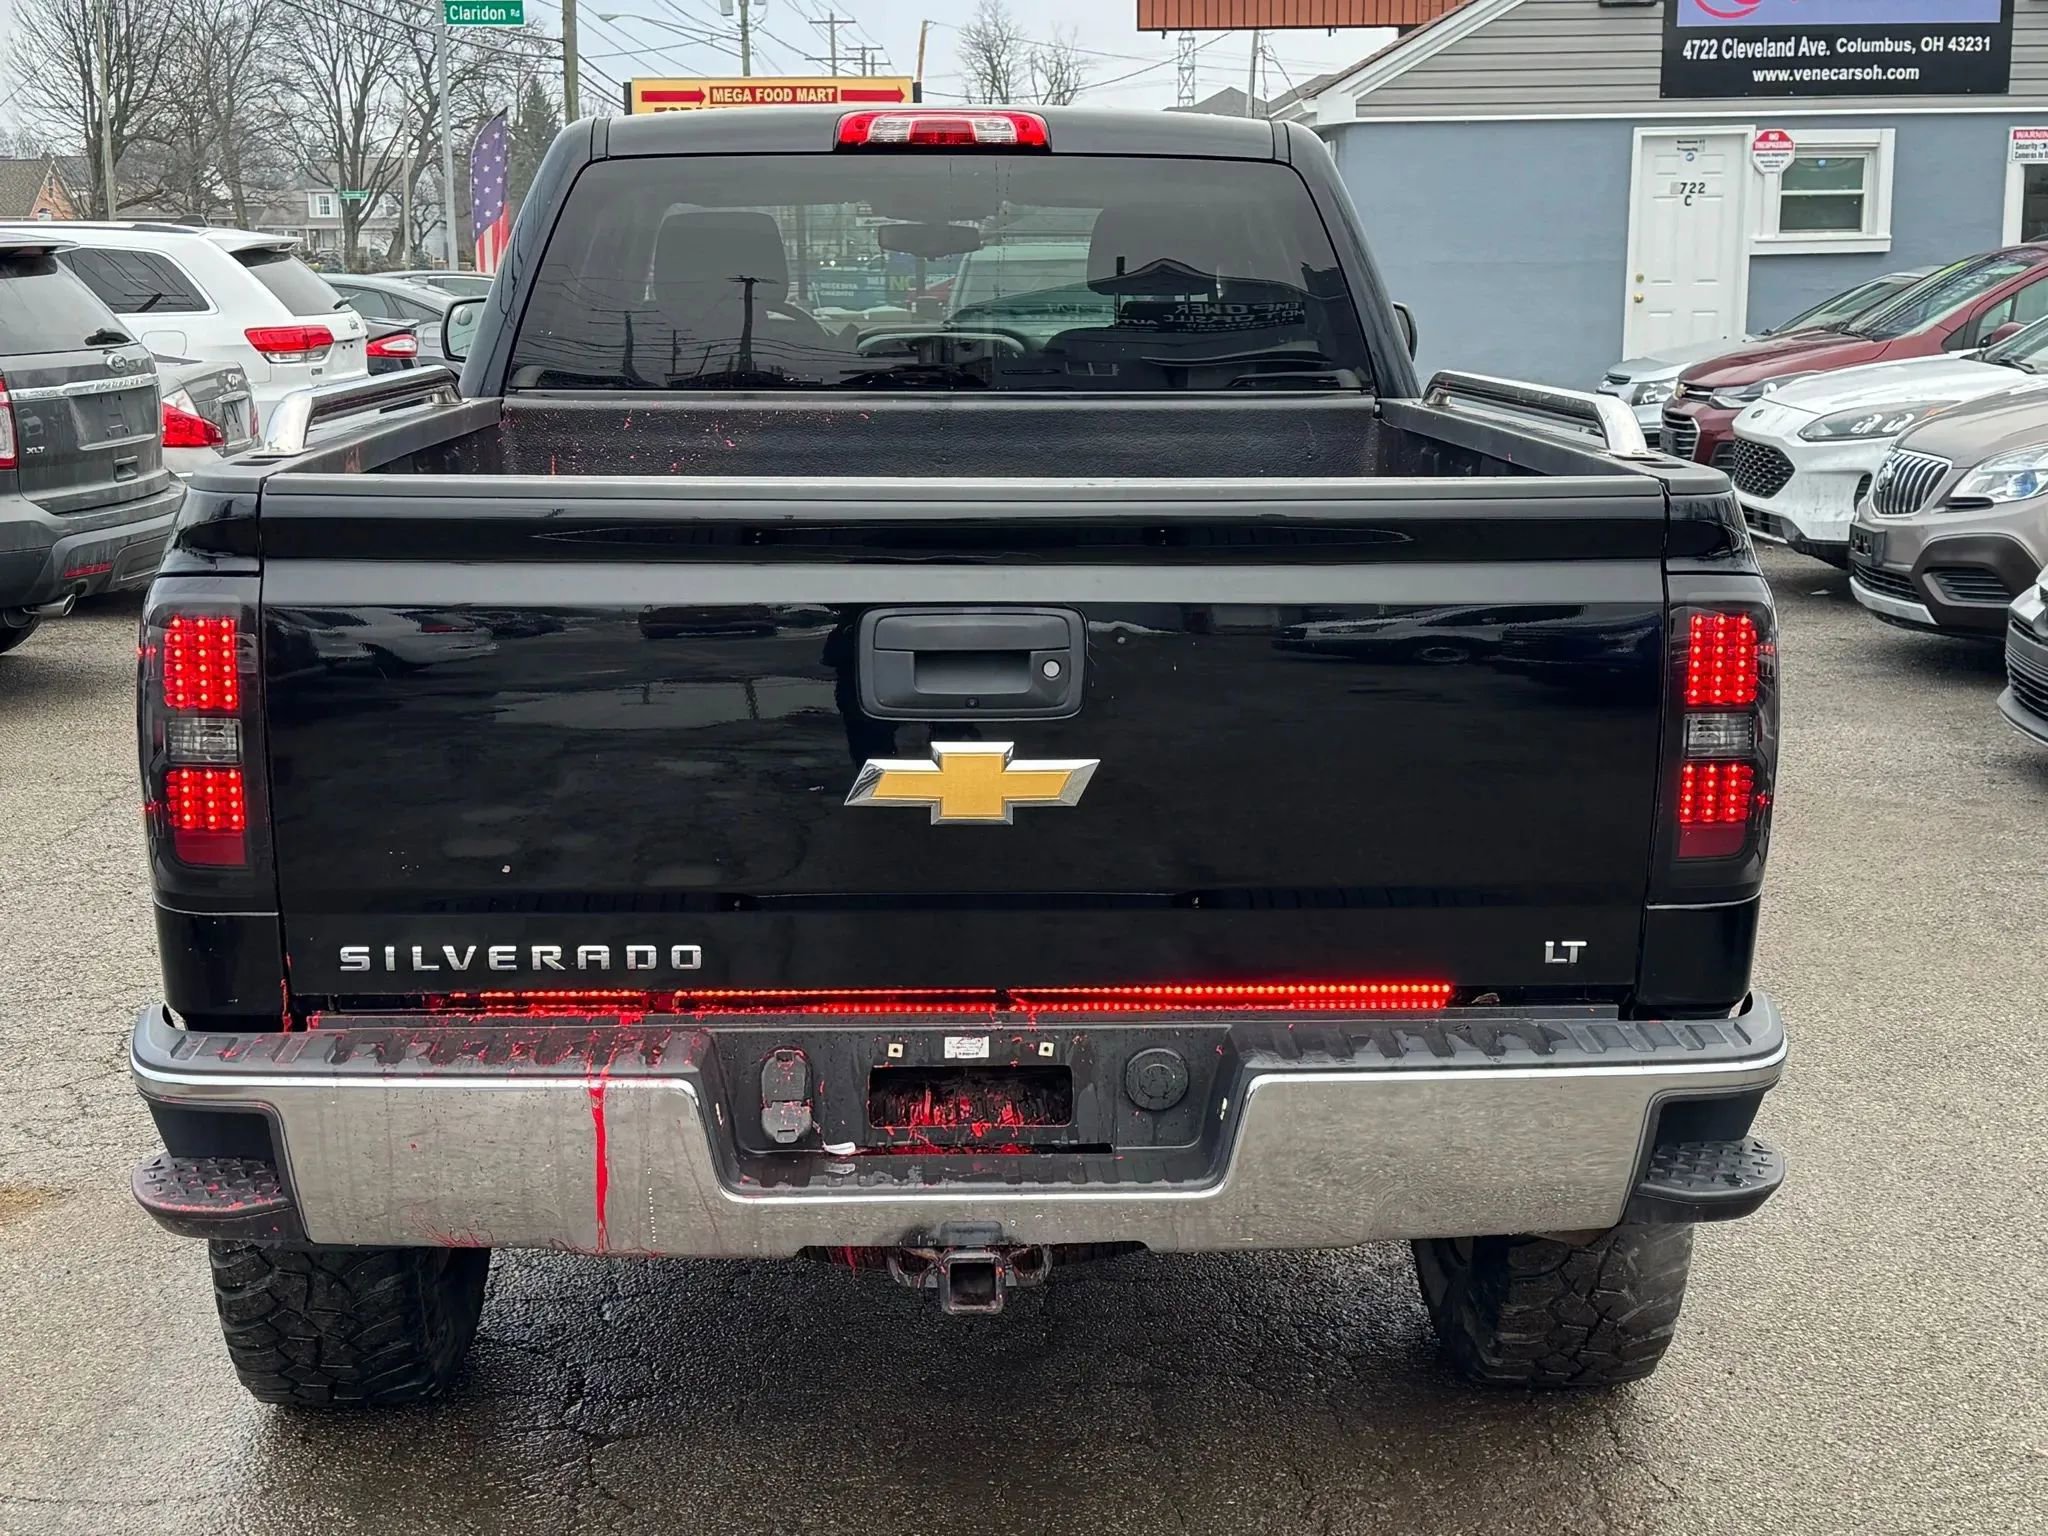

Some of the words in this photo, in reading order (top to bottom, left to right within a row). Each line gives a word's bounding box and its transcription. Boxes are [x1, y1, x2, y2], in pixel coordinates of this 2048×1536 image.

[449, 5, 506, 20] Claridon
[1683, 38, 1718, 60] 4722
[1722, 36, 1795, 59] Cleveland
[1798, 36, 1831, 57] Ave.
[1836, 37, 1917, 54] Columbus,
[1920, 36, 1944, 52] OH
[1948, 36, 1991, 52] 43231
[1752, 64, 1920, 82] www.venecarsoh.com
[712, 88, 752, 102] MEGA
[755, 88, 793, 102] FOOD
[796, 88, 835, 102] MART
[1680, 182, 1705, 195] 722
[1684, 195, 1692, 207] C
[26, 446, 45, 454] XLT
[340, 944, 702, 971] SILVERADO
[1544, 941, 1588, 964] LT
